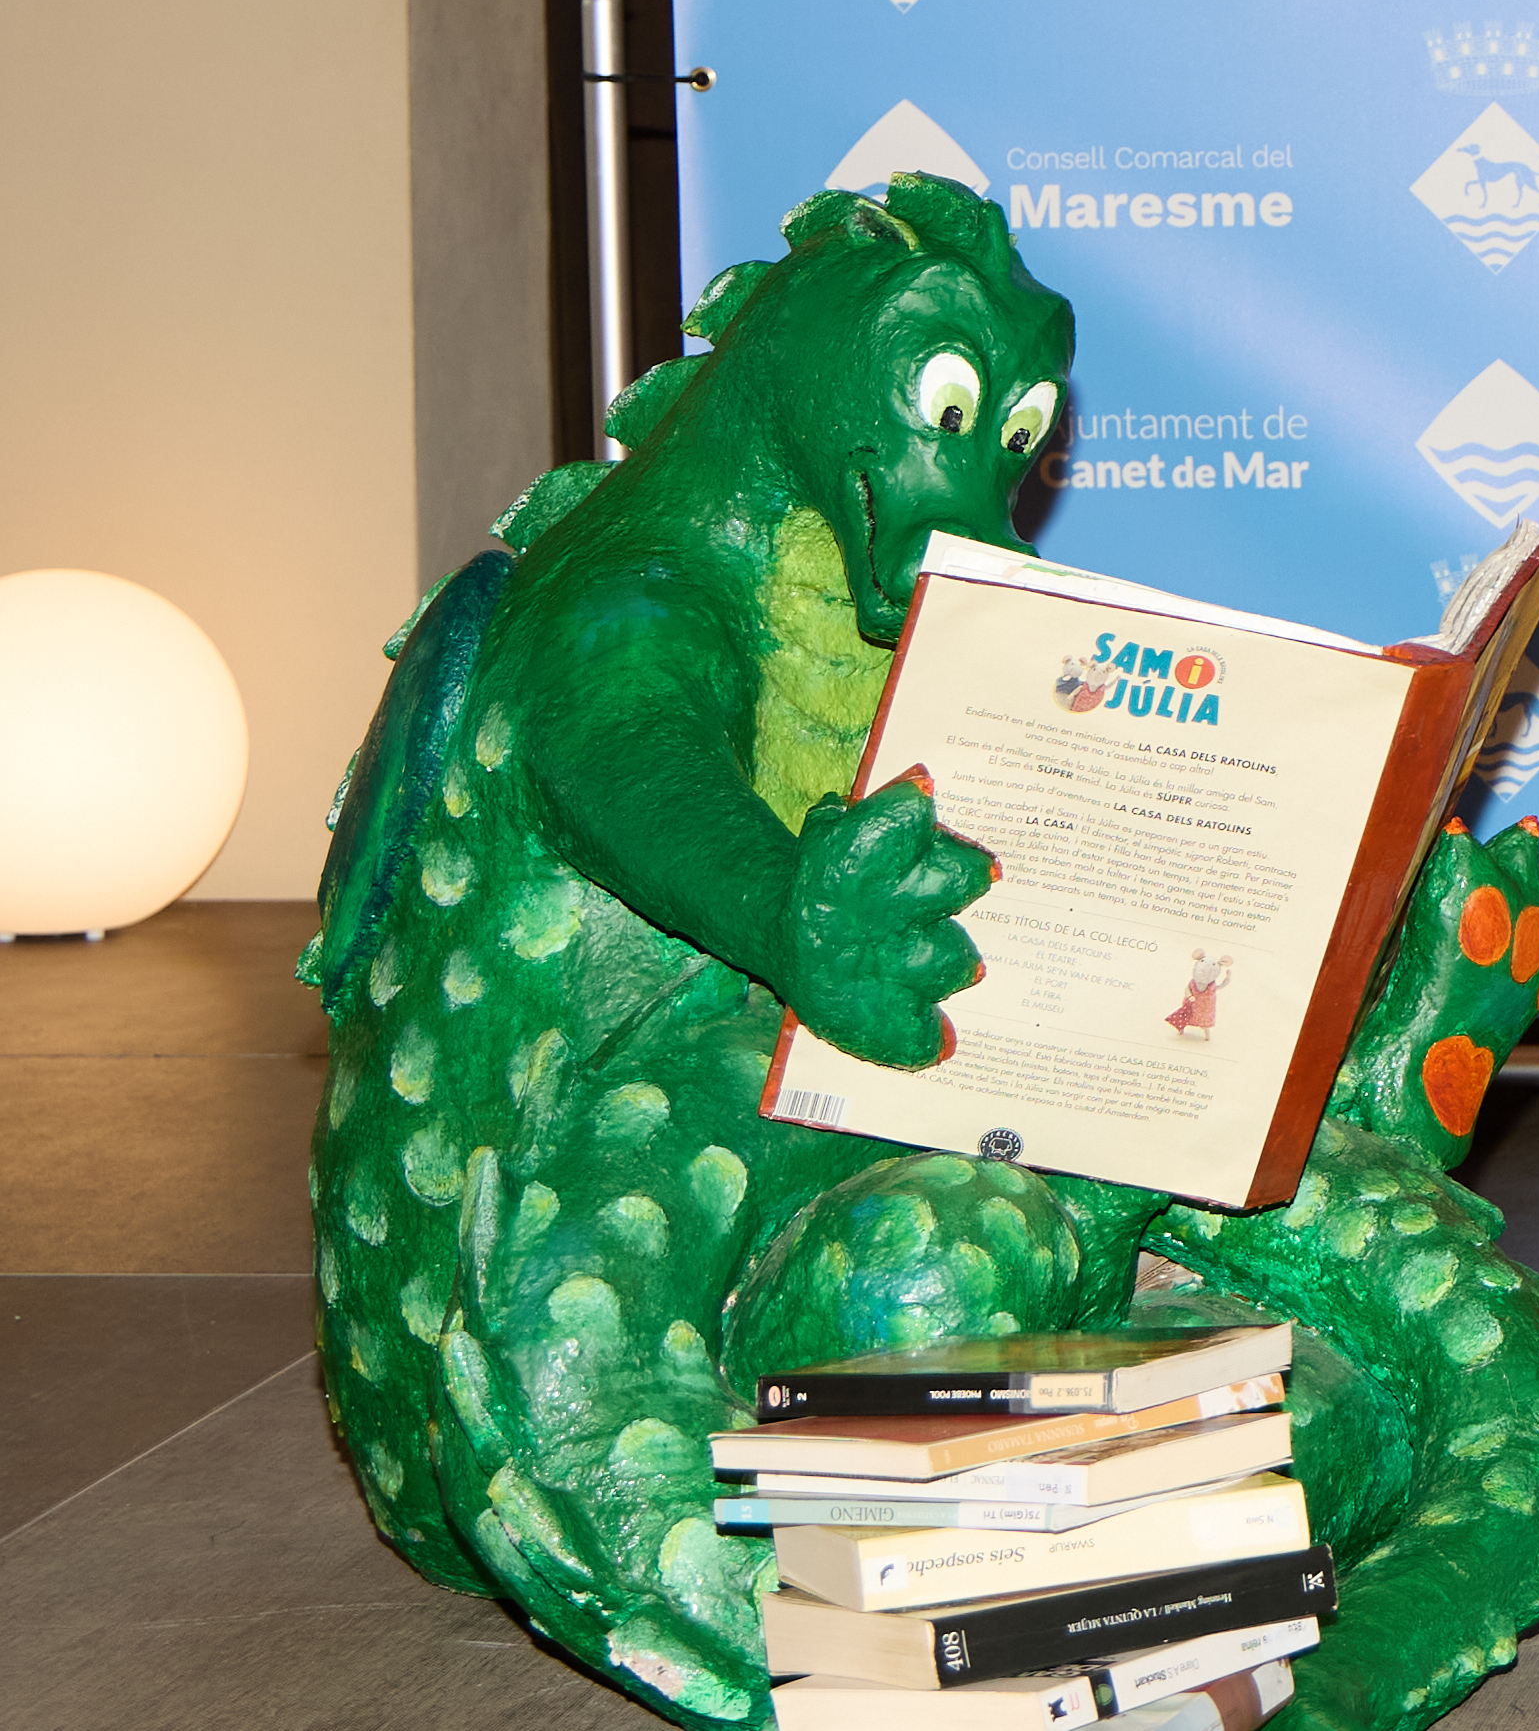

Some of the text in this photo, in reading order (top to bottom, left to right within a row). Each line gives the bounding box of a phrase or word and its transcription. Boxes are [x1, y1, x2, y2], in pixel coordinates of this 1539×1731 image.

[1091, 632, 1173, 679] SAM
[1103, 678, 1220, 726] JÚLIA
[1137, 742, 1152, 754] LA
[1155, 745, 1187, 759] CASA
[1190, 750, 1217, 764] DELS
[1130, 806, 1162, 821] CASA
[1165, 814, 1193, 826] DELS
[969, 909, 1159, 953] ALTRES TÍTOLS DE LA COL·LECCIÓ
[929, 1389, 951, 1399] POOL
[951, 1389, 982, 1399] PHOEBE
[987, 1422, 1085, 1453] SUSANNA TAMARO
[830, 1505, 895, 1523] GIMENO
[990, 1546, 1025, 1563] Seis
[1048, 1538, 1095, 1554] SWARUP
[1103, 1608, 1143, 1627] QUINTA
[1143, 1606, 1157, 1620] LA
[1066, 1615, 1102, 1634] MUJER
[941, 1631, 964, 1672] 408
